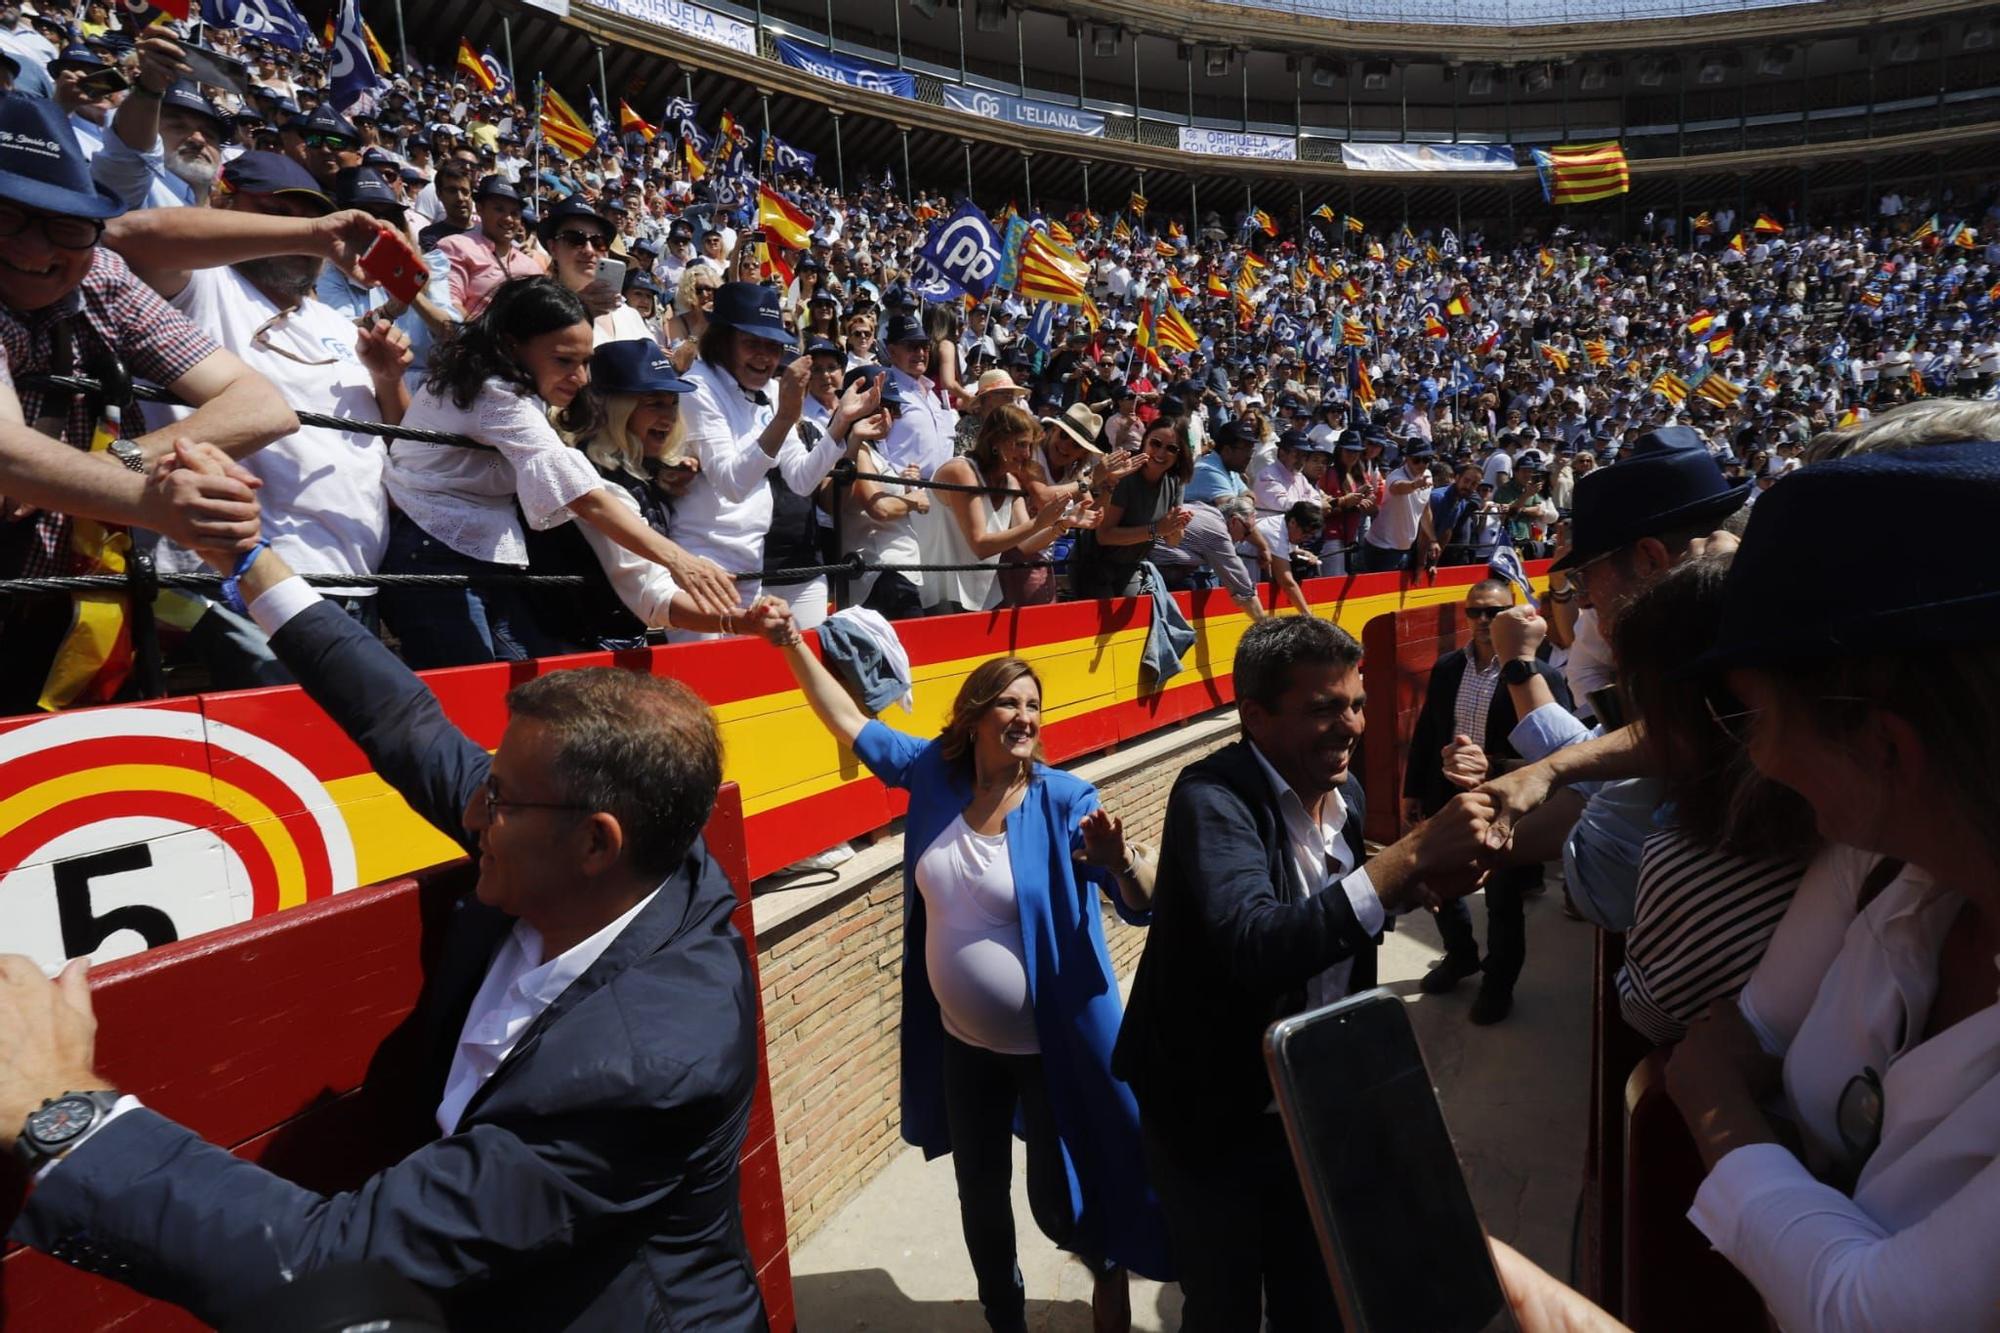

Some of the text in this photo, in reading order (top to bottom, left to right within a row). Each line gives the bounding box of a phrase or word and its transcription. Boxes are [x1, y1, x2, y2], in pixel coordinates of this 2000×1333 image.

[981, 101, 1079, 129] PP L'ELIANA
[1184, 142, 1207, 152] CON
[1207, 132, 1269, 148] ORIHUELA
[943, 235, 994, 284] PP
[53, 843, 178, 961] 5
